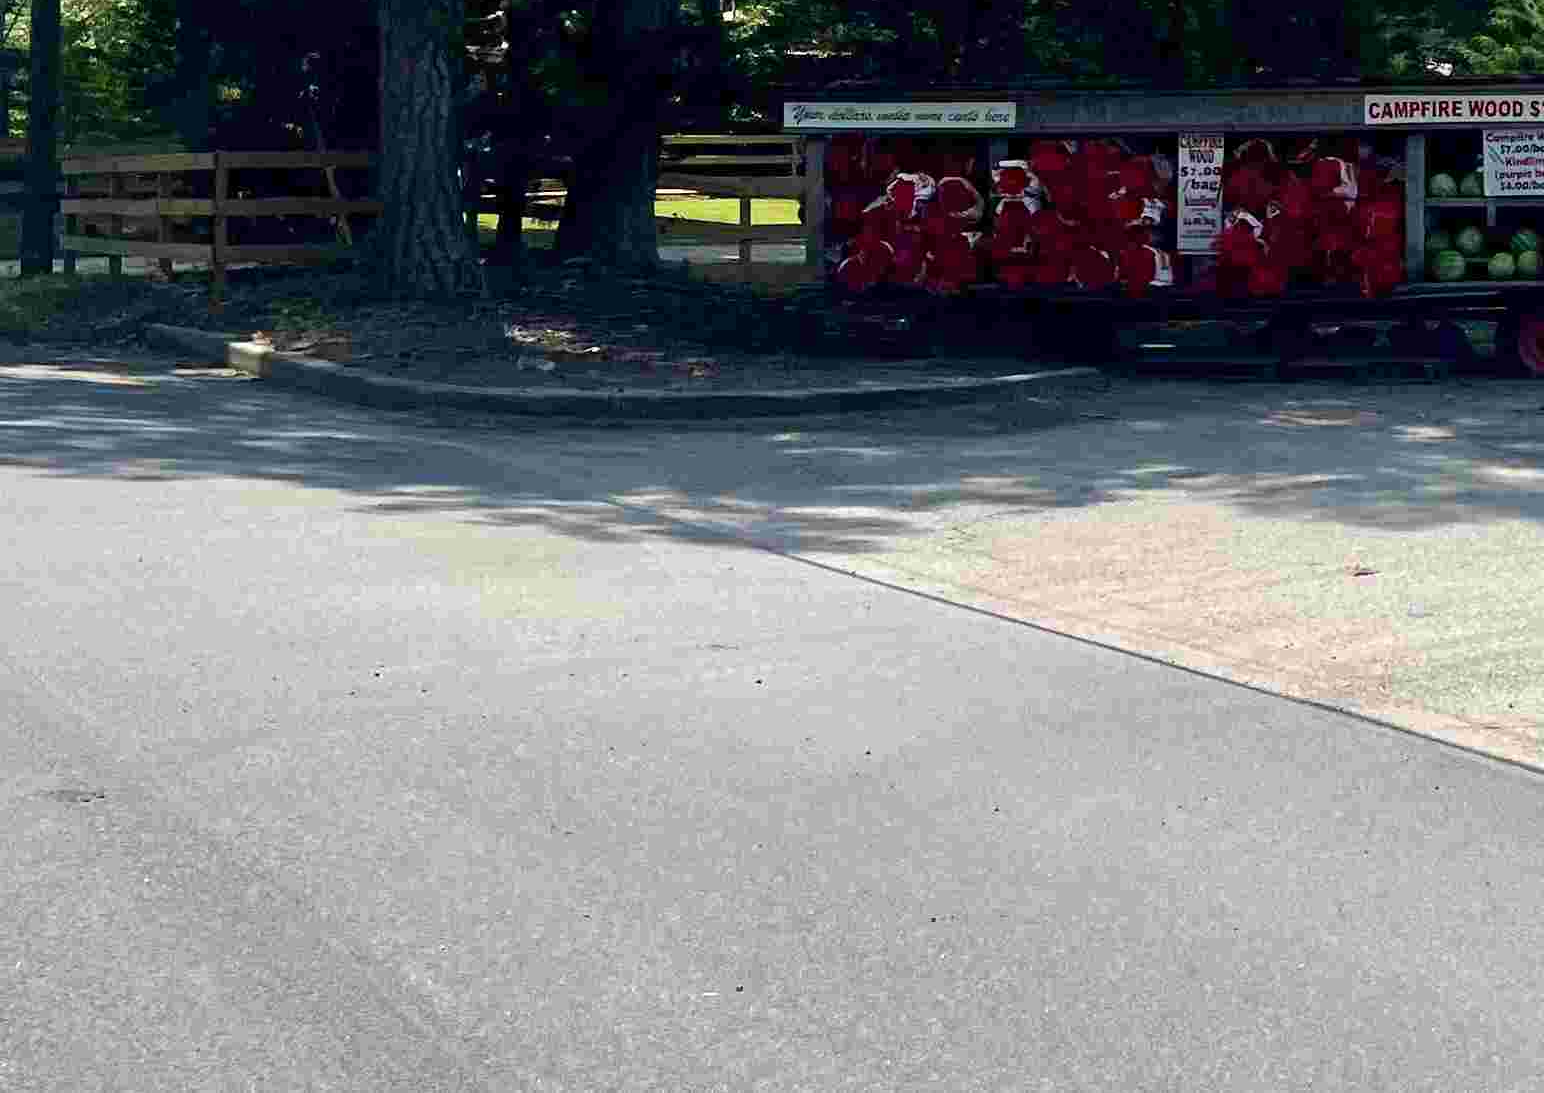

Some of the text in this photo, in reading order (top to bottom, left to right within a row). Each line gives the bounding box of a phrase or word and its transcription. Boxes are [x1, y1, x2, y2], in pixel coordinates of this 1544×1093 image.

[792, 105, 823, 126] Your
[1368, 100, 1463, 119] CAMPFIRE
[1468, 100, 1522, 118] WOOD
